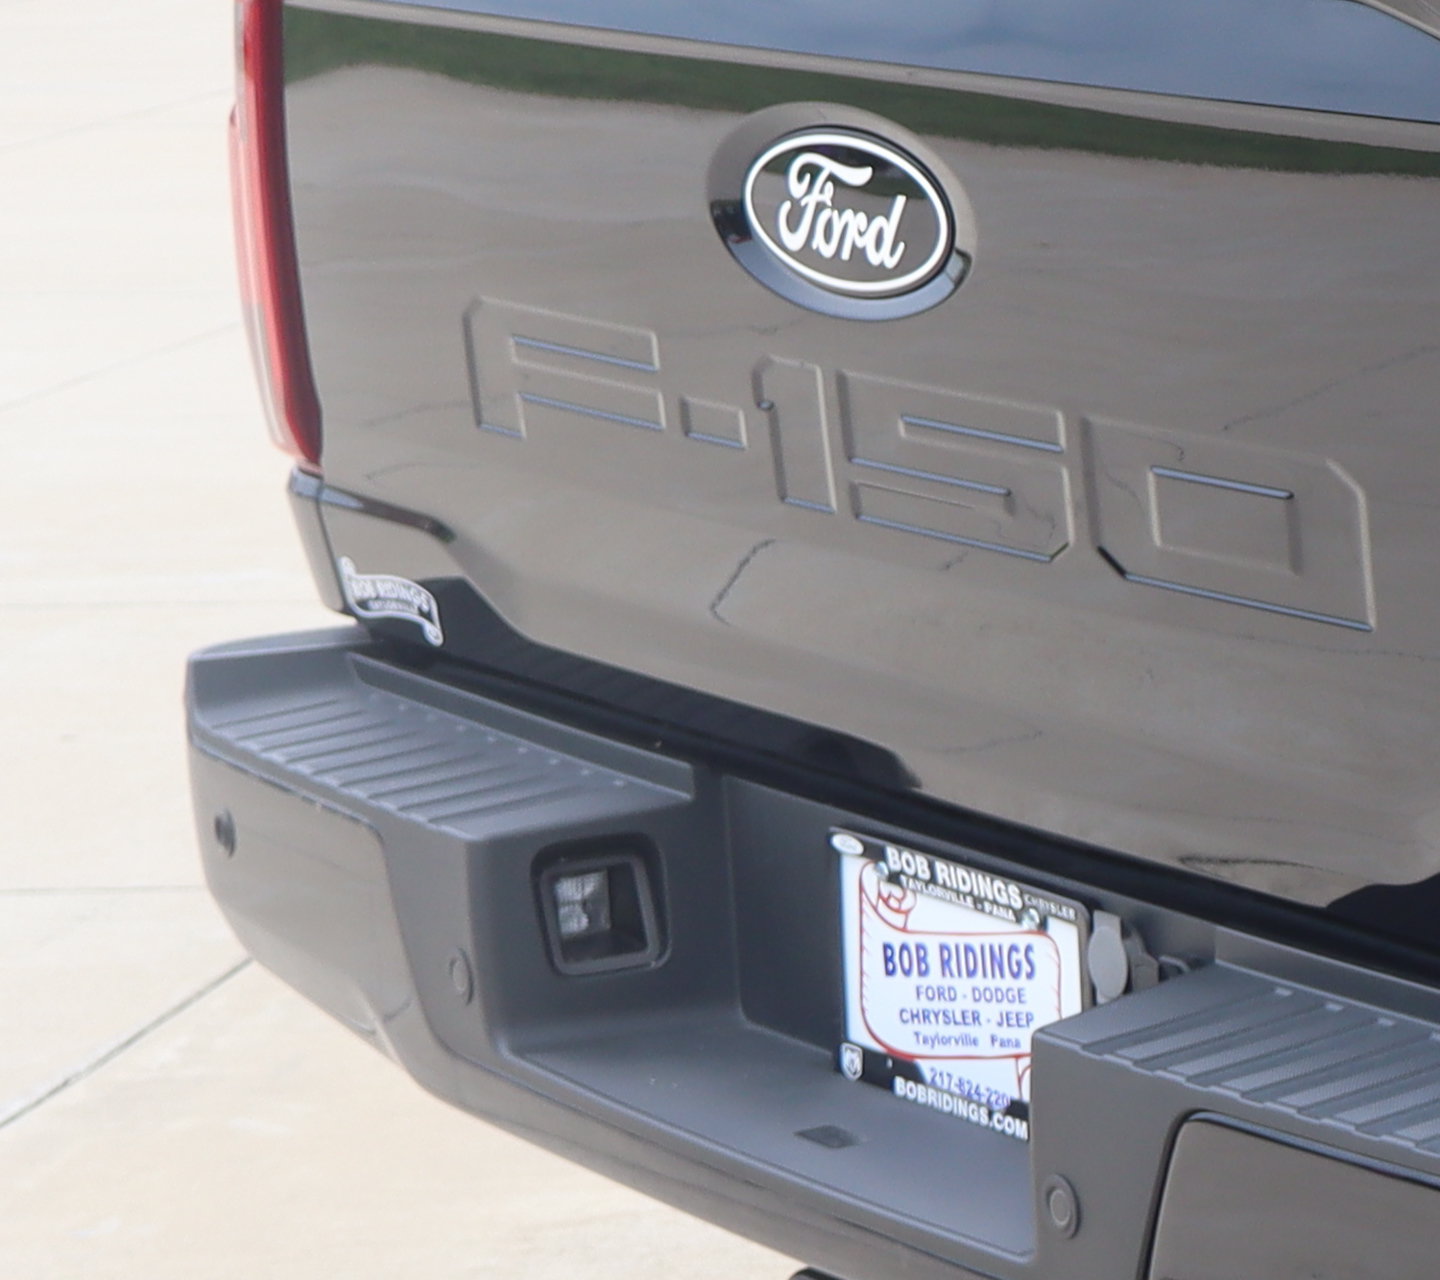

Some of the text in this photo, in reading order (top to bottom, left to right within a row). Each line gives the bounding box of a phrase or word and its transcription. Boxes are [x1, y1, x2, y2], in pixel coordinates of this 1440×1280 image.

[778, 152, 907, 269] Ford
[463, 295, 1376, 633] F-150
[885, 846, 1024, 910] BOB RIDINGS
[901, 875, 975, 910] TAYLORVILLE
[985, 900, 1016, 922] PANA
[1024, 893, 1076, 921] CHRYSLER
[883, 941, 1036, 981] BOB RIDINGS
[916, 985, 957, 1003] FORD
[972, 986, 1027, 1005] DODGE
[899, 1008, 982, 1027] CHRYSLER
[996, 1011, 1034, 1029] JEEP
[913, 1031, 1022, 1050] Taylorville Pana
[893, 1075, 1029, 1141] BOBRIDINGS.COM
[929, 1066, 1016, 1108] 217-824-220
